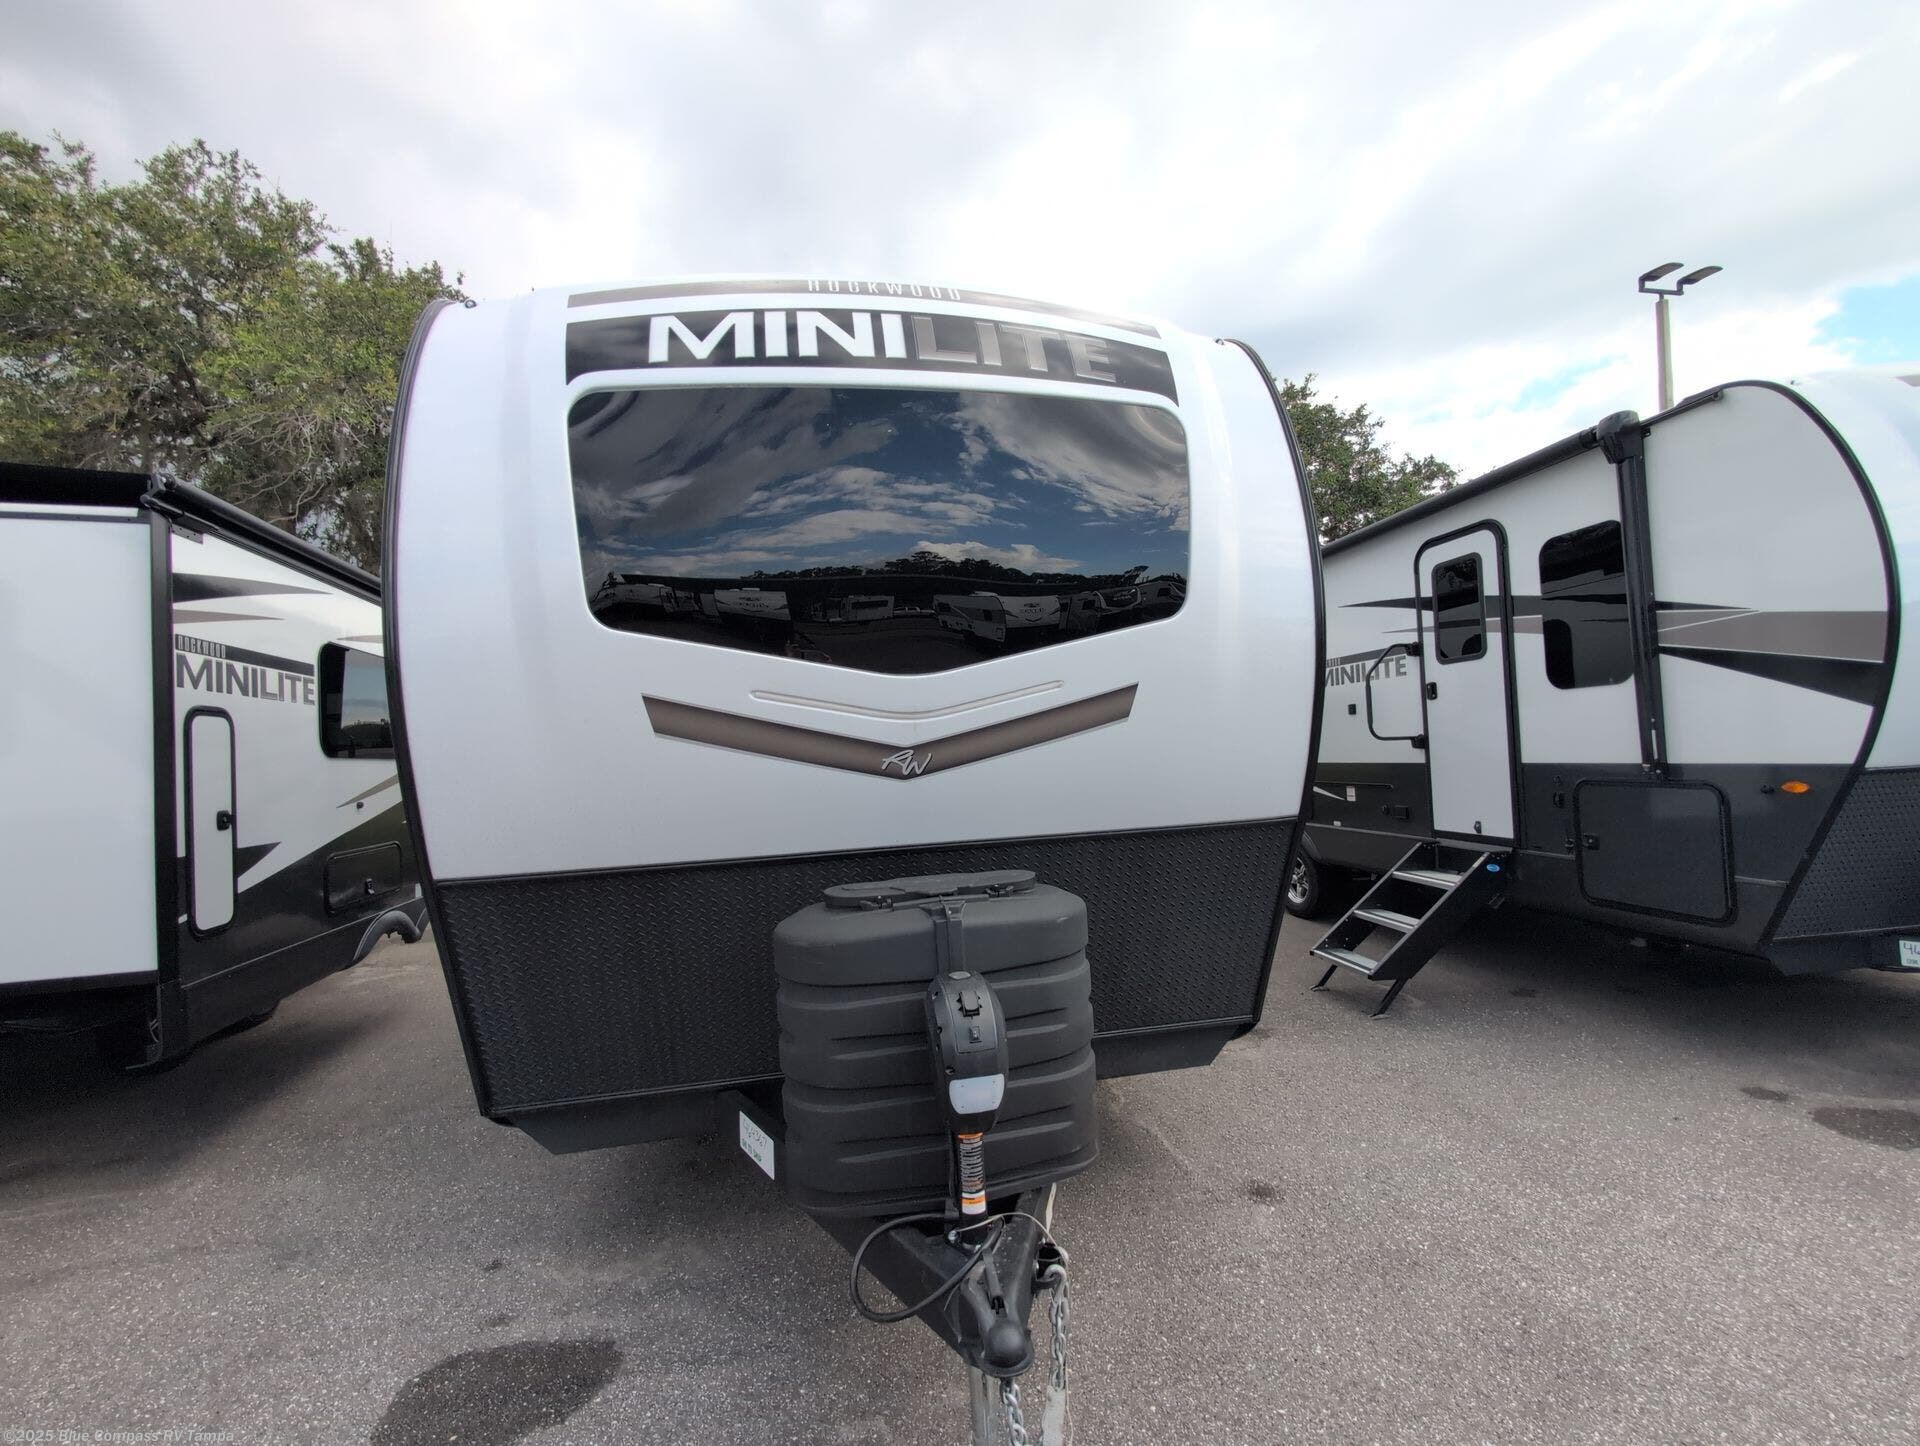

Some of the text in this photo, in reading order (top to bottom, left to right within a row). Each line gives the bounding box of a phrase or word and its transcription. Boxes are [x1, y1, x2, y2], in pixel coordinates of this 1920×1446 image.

[177, 635, 227, 659] ROCKWOOD
[176, 652, 315, 706] MINILITE
[881, 749, 932, 776] RW
